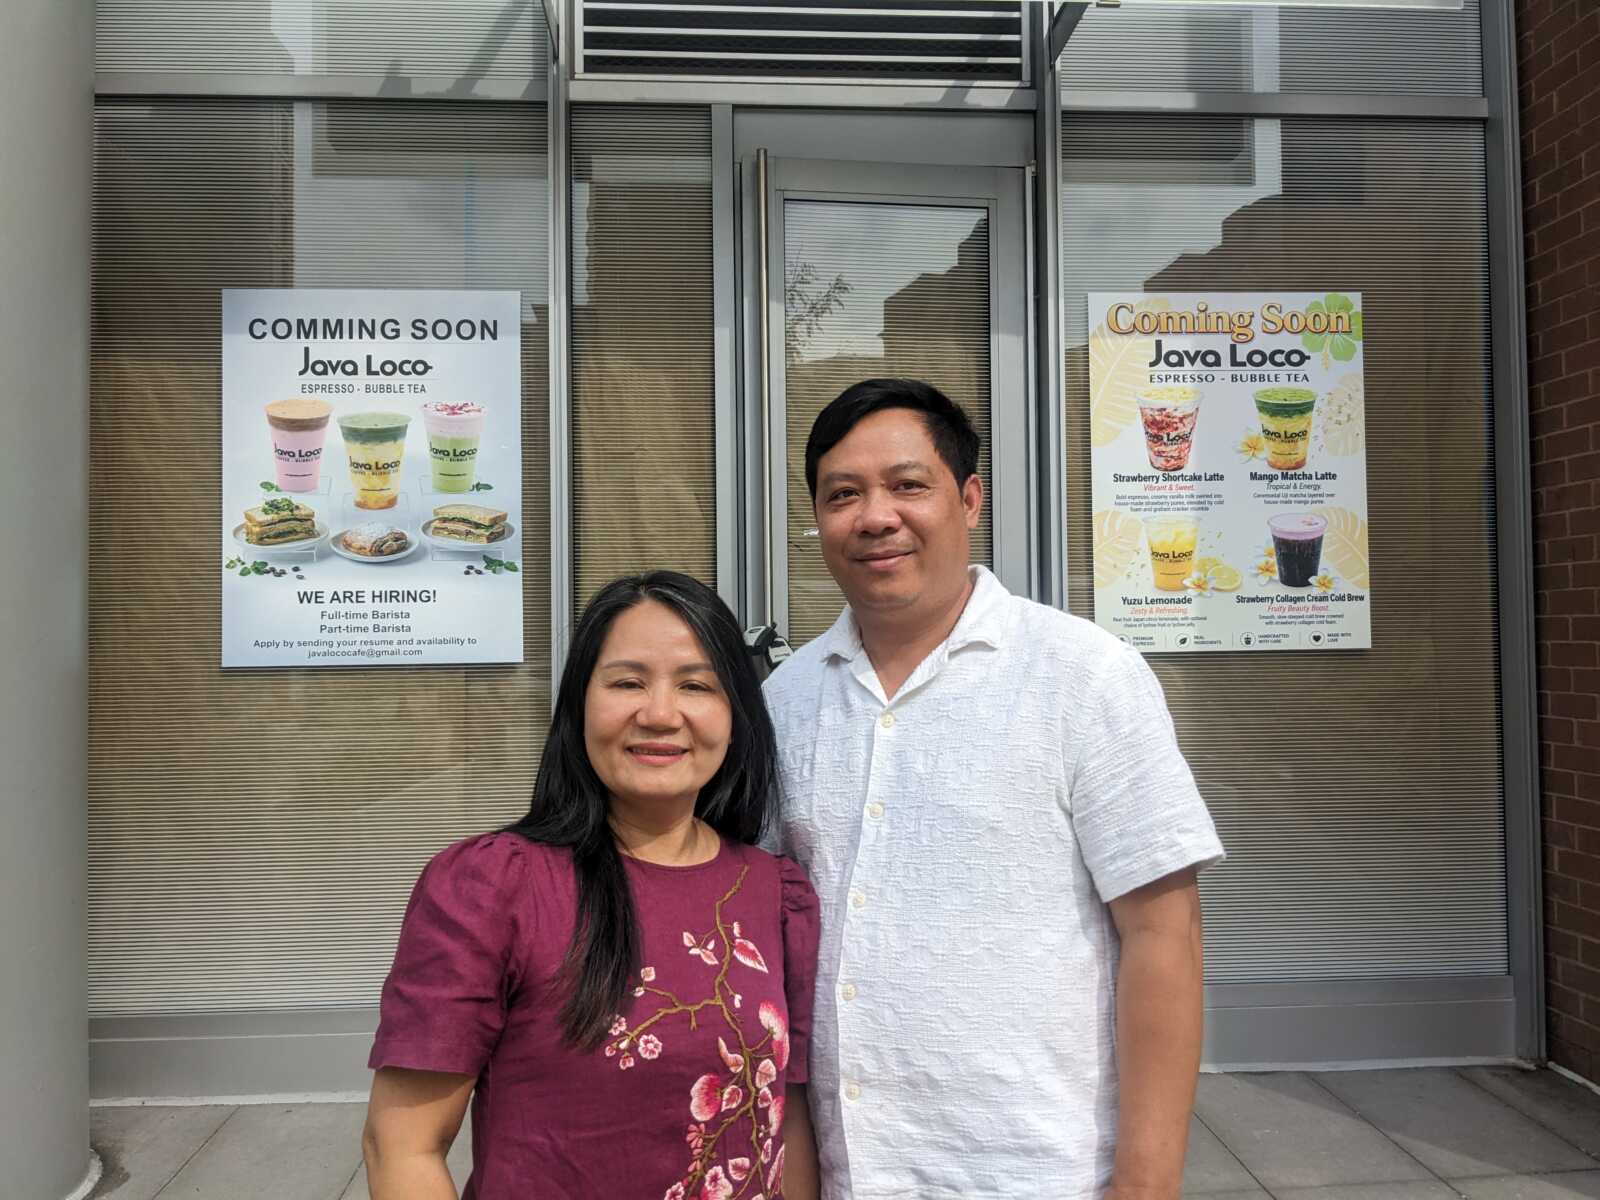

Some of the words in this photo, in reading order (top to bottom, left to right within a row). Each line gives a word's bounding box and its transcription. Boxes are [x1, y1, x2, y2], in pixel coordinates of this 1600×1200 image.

[1106, 302, 1255, 344] Coming
[1260, 303, 1353, 335] Soon
[248, 318, 401, 341] COMMING
[411, 318, 499, 342] SOON
[1148, 340, 1222, 368] Java
[1229, 343, 1311, 368] Loco
[298, 346, 359, 377] Java
[365, 354, 434, 377] Loco
[1149, 373, 1216, 384] ESPRESSO
[1230, 373, 1282, 384] BUBBLE
[1286, 373, 1311, 383] TEA
[301, 383, 356, 394] ESPRESSO
[364, 383, 405, 394] BUBBLE
[406, 383, 428, 394] TEA
[1113, 473, 1160, 483] Strawberry
[1161, 473, 1203, 482] Shortcake
[1204, 472, 1225, 481] Latte
[1249, 471, 1279, 482] Mango
[1280, 471, 1313, 481] Matcha
[1315, 471, 1338, 480] Latte
[1266, 482, 1292, 491] Tropical
[297, 590, 325, 604] WE
[329, 590, 366, 604] ARE
[371, 589, 437, 604] HIRING!
[1121, 596, 1143, 605] Yuzu
[1144, 595, 1193, 605] Lemonade
[1236, 595, 1275, 604] Strawberry
[1275, 594, 1306, 604] Collagen
[1306, 594, 1329, 603] Cream
[1330, 593, 1346, 602] Cold
[1347, 593, 1365, 601] Brew
[1267, 605, 1287, 613] Fruity
[1287, 605, 1311, 613] Beauty
[320, 610, 369, 620] Full-time
[371, 610, 411, 620] Barista
[320, 624, 369, 634] Part-time
[372, 624, 411, 633] Barista
[253, 639, 281, 649] Apply
[282, 639, 295, 649] by
[296, 638, 335, 649] sending
[336, 639, 358, 648] your
[359, 639, 394, 647] resume
[396, 637, 415, 646] and
[416, 636, 466, 647] availability
[467, 637, 478, 645] to
[306, 647, 423, 659] javalococafe@gmail.com
